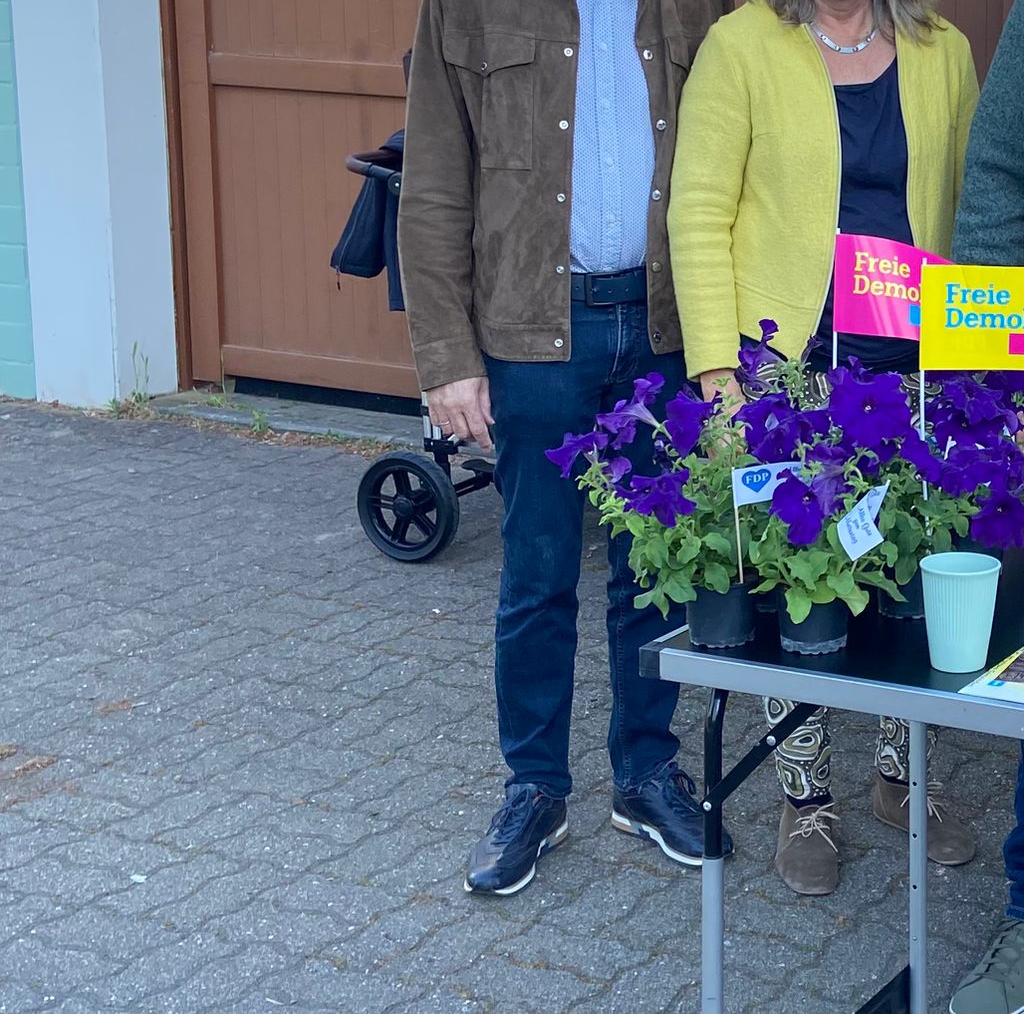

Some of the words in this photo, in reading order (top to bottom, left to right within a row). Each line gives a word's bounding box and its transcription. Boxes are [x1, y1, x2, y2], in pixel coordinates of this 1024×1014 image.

[854, 251, 911, 278] Freie
[852, 274, 921, 303] Demo
[945, 283, 1011, 305] Freie
[745, 472, 769, 484] FDP
